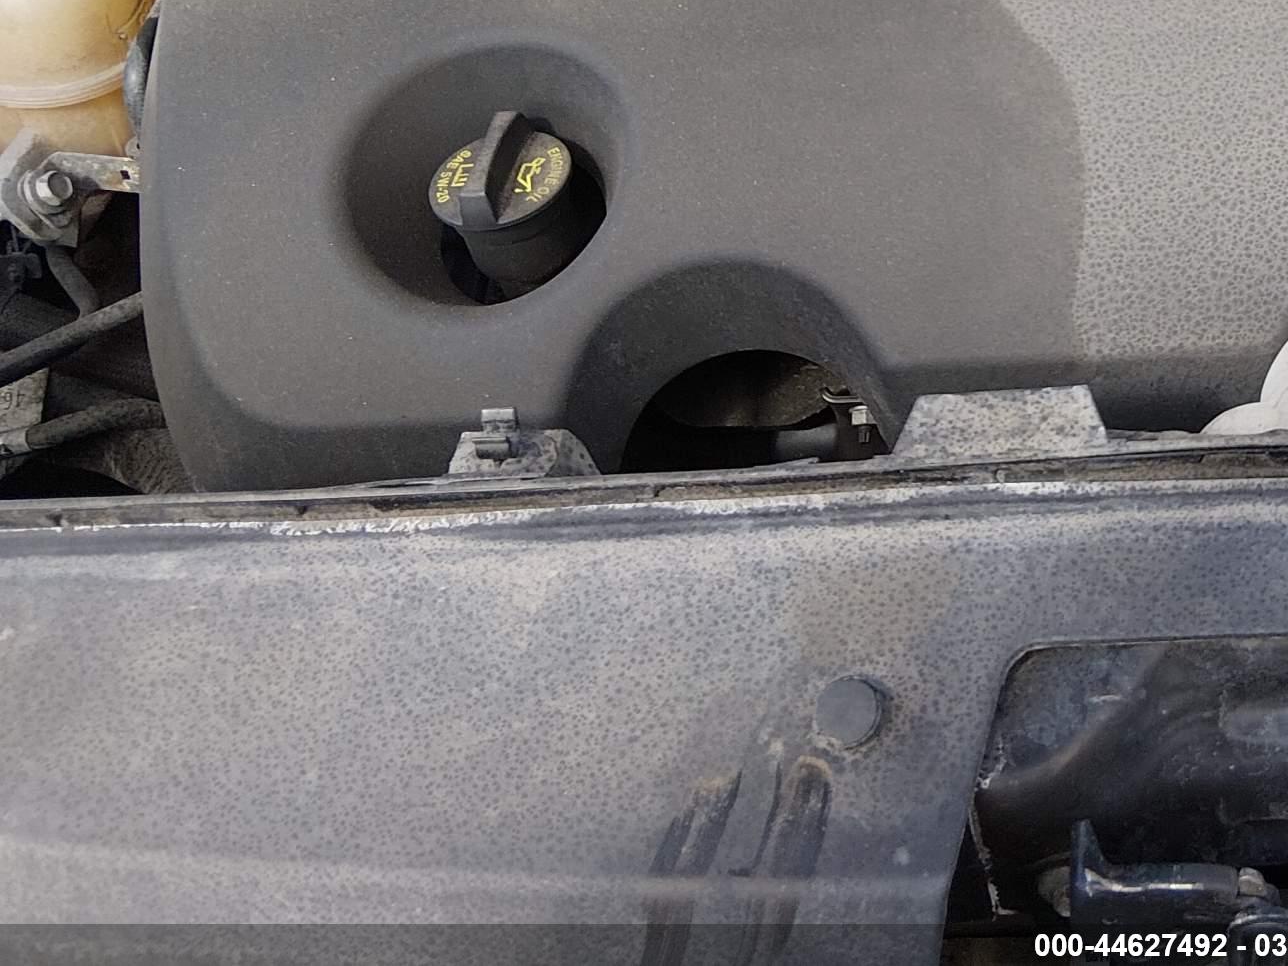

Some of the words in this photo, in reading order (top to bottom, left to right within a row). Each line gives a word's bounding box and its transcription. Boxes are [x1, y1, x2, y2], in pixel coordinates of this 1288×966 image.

[544, 146, 561, 186] ENGINE
[436, 171, 453, 203] 5W-20
[525, 186, 550, 202] OIL
